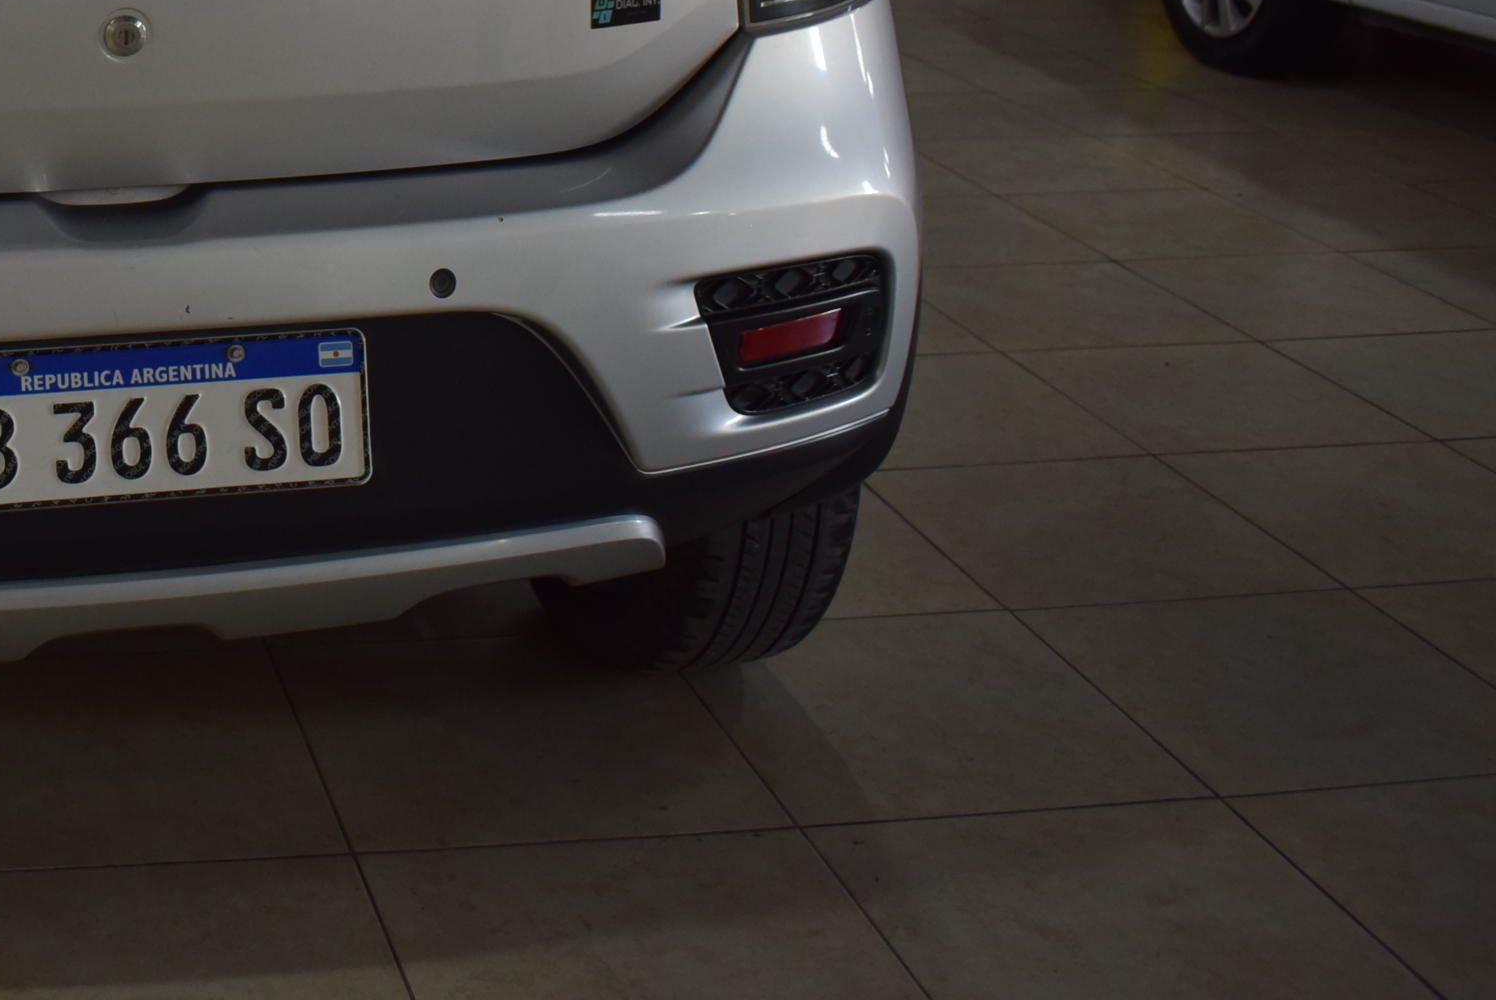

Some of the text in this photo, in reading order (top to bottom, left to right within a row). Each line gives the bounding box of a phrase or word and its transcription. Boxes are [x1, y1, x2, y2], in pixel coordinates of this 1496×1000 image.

[20, 361, 237, 392] REPUBLICA ARGENTINA
[51, 393, 208, 485] 366
[244, 383, 342, 471] SO
